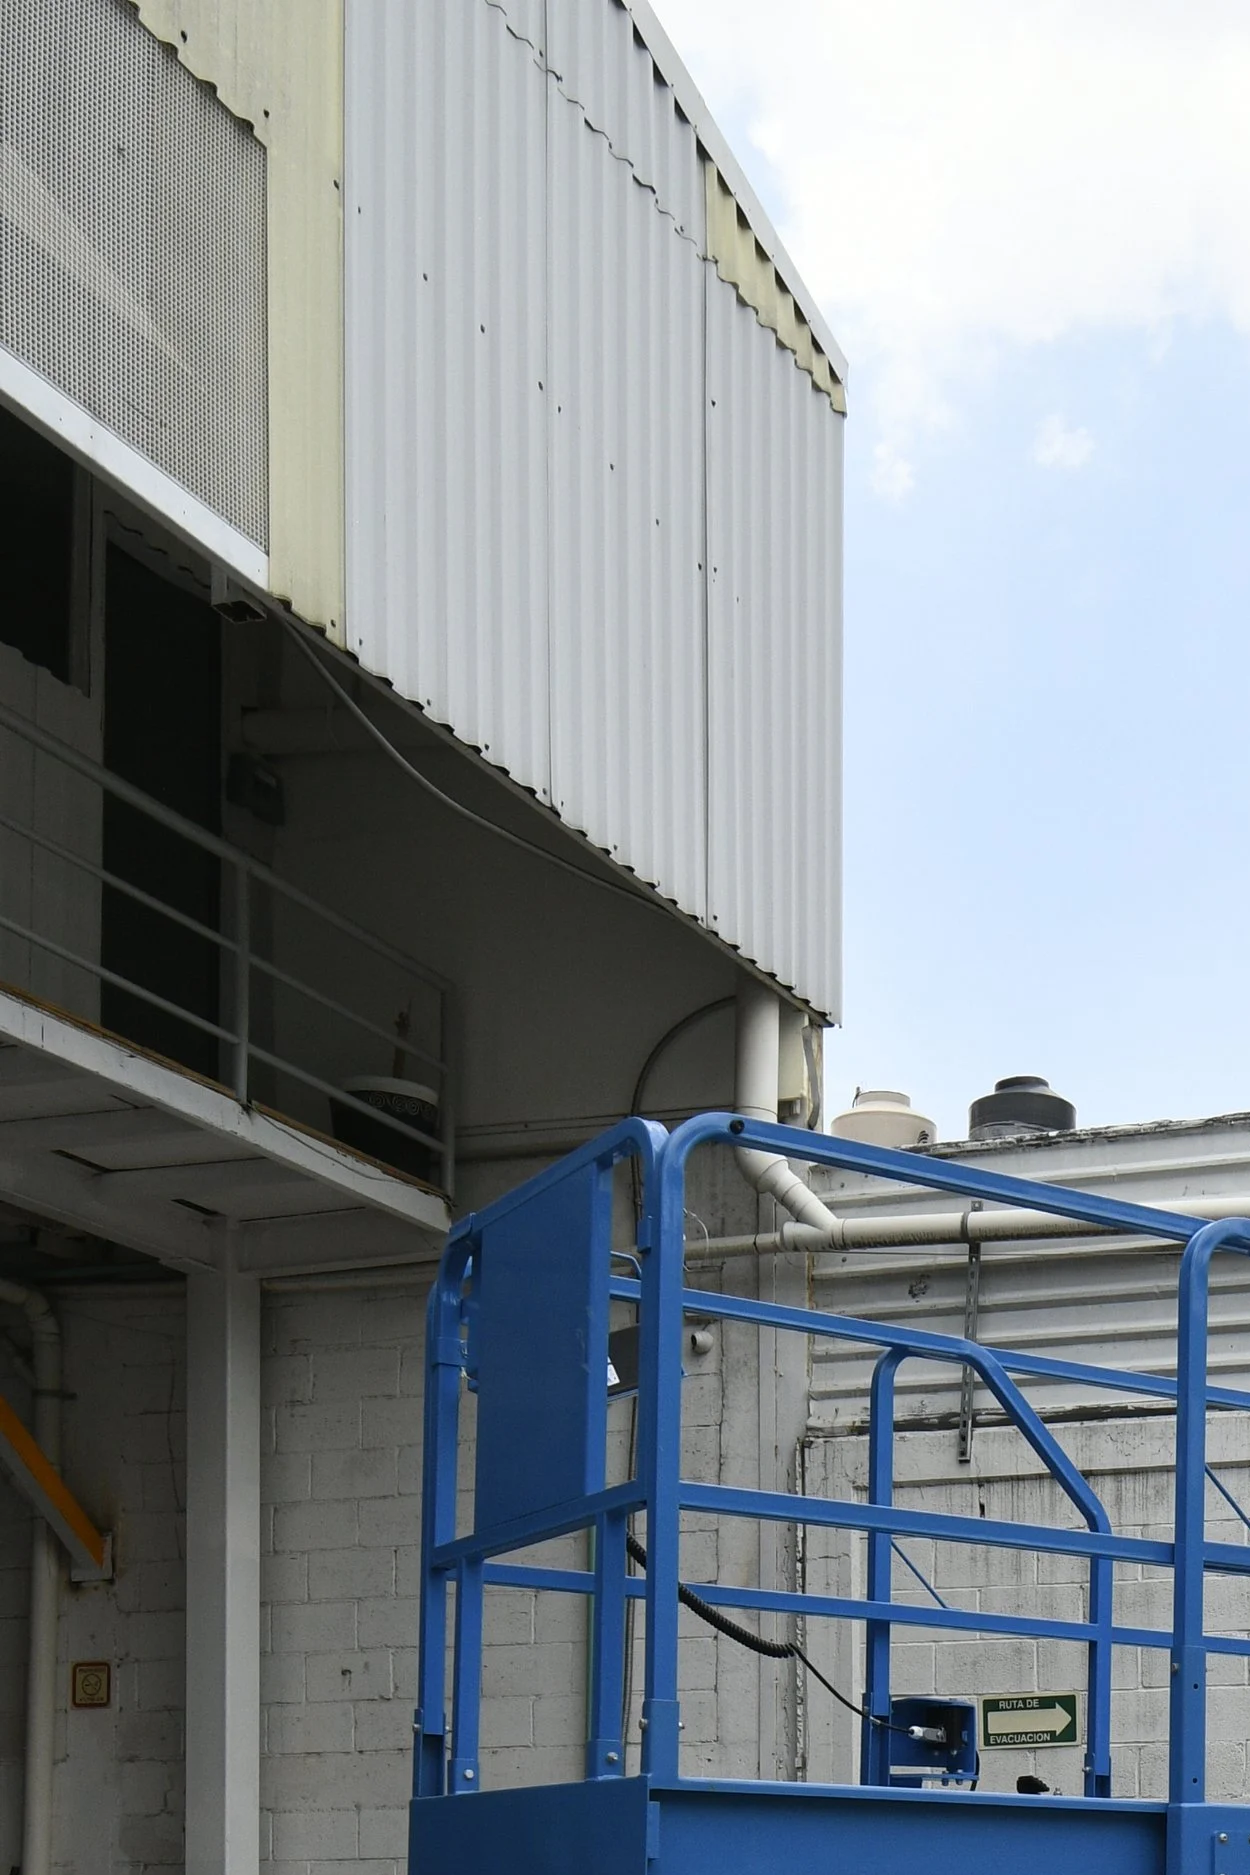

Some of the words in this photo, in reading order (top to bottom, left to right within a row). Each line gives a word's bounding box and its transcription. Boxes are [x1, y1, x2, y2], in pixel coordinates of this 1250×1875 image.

[999, 1700, 1024, 1709] RUTA
[1026, 1699, 1039, 1708] DE
[989, 1733, 1050, 1744] EVACUACION
